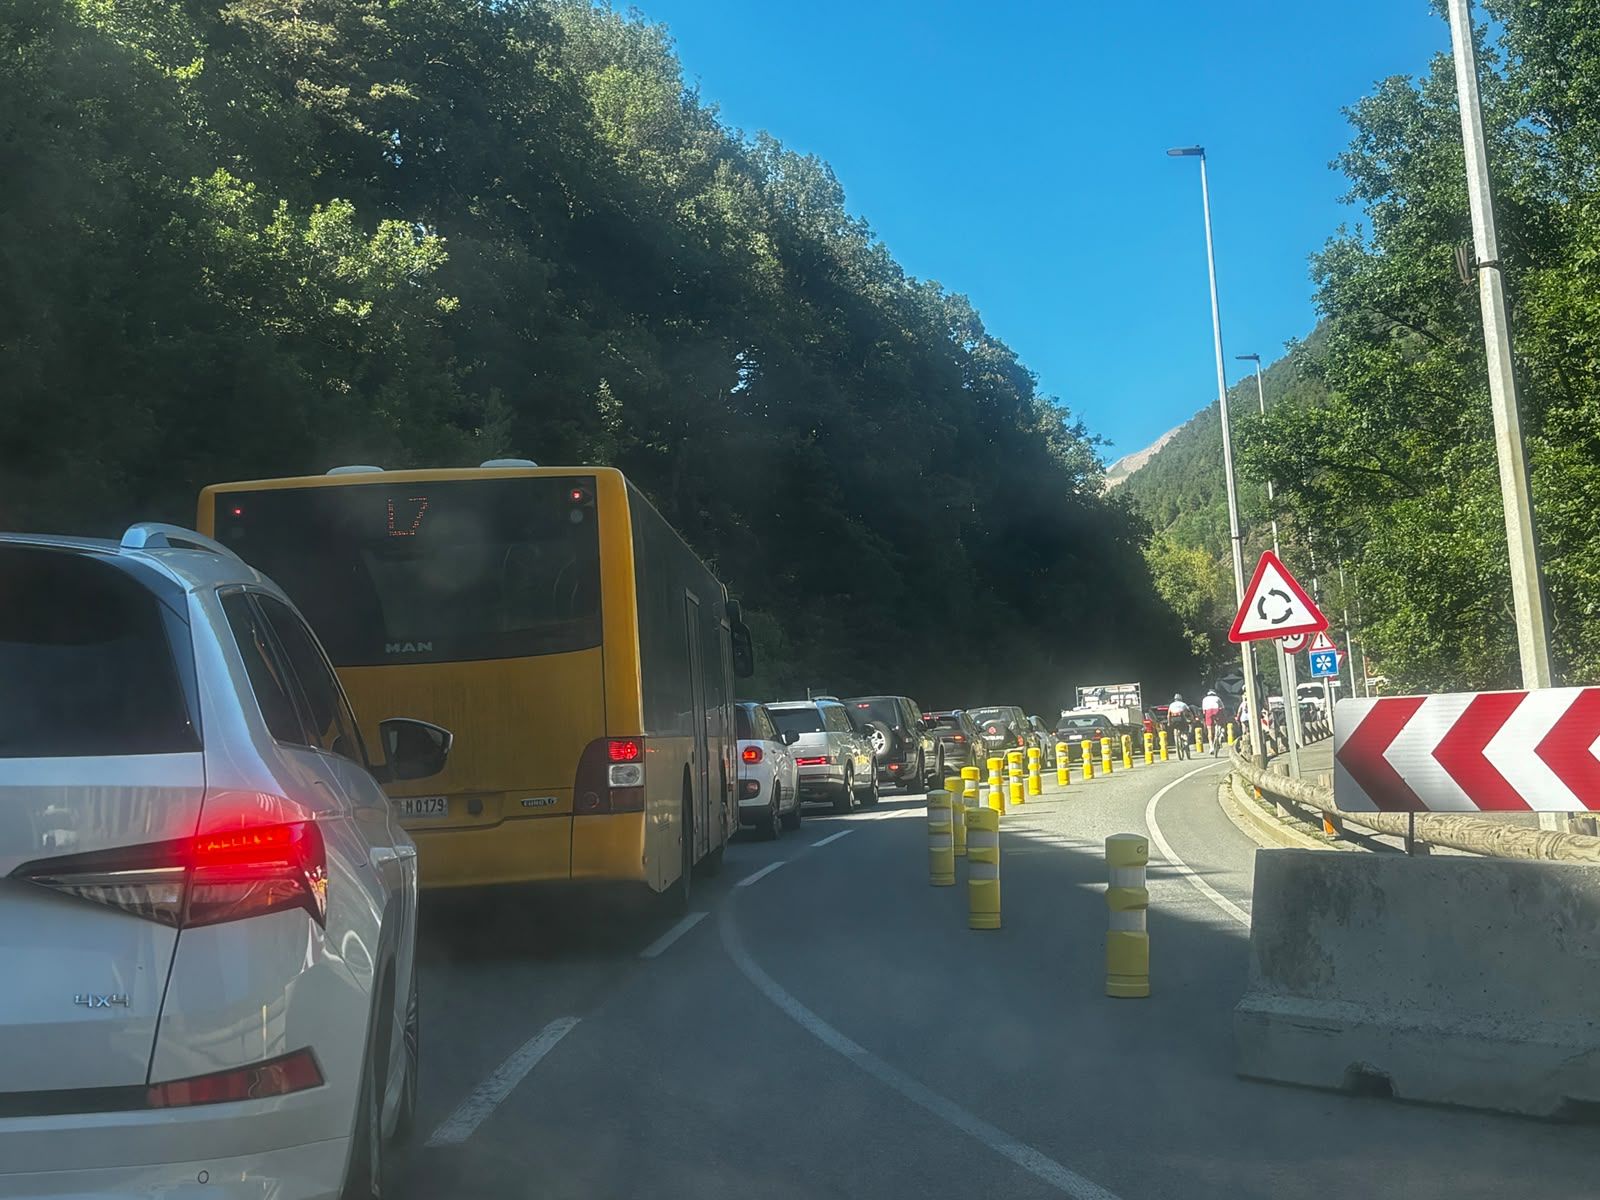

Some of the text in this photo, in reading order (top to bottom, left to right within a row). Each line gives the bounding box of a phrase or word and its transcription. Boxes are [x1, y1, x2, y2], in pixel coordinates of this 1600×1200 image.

[388, 497, 428, 536] L7
[385, 642, 433, 653] MAN
[75, 993, 130, 1007] 4x4
